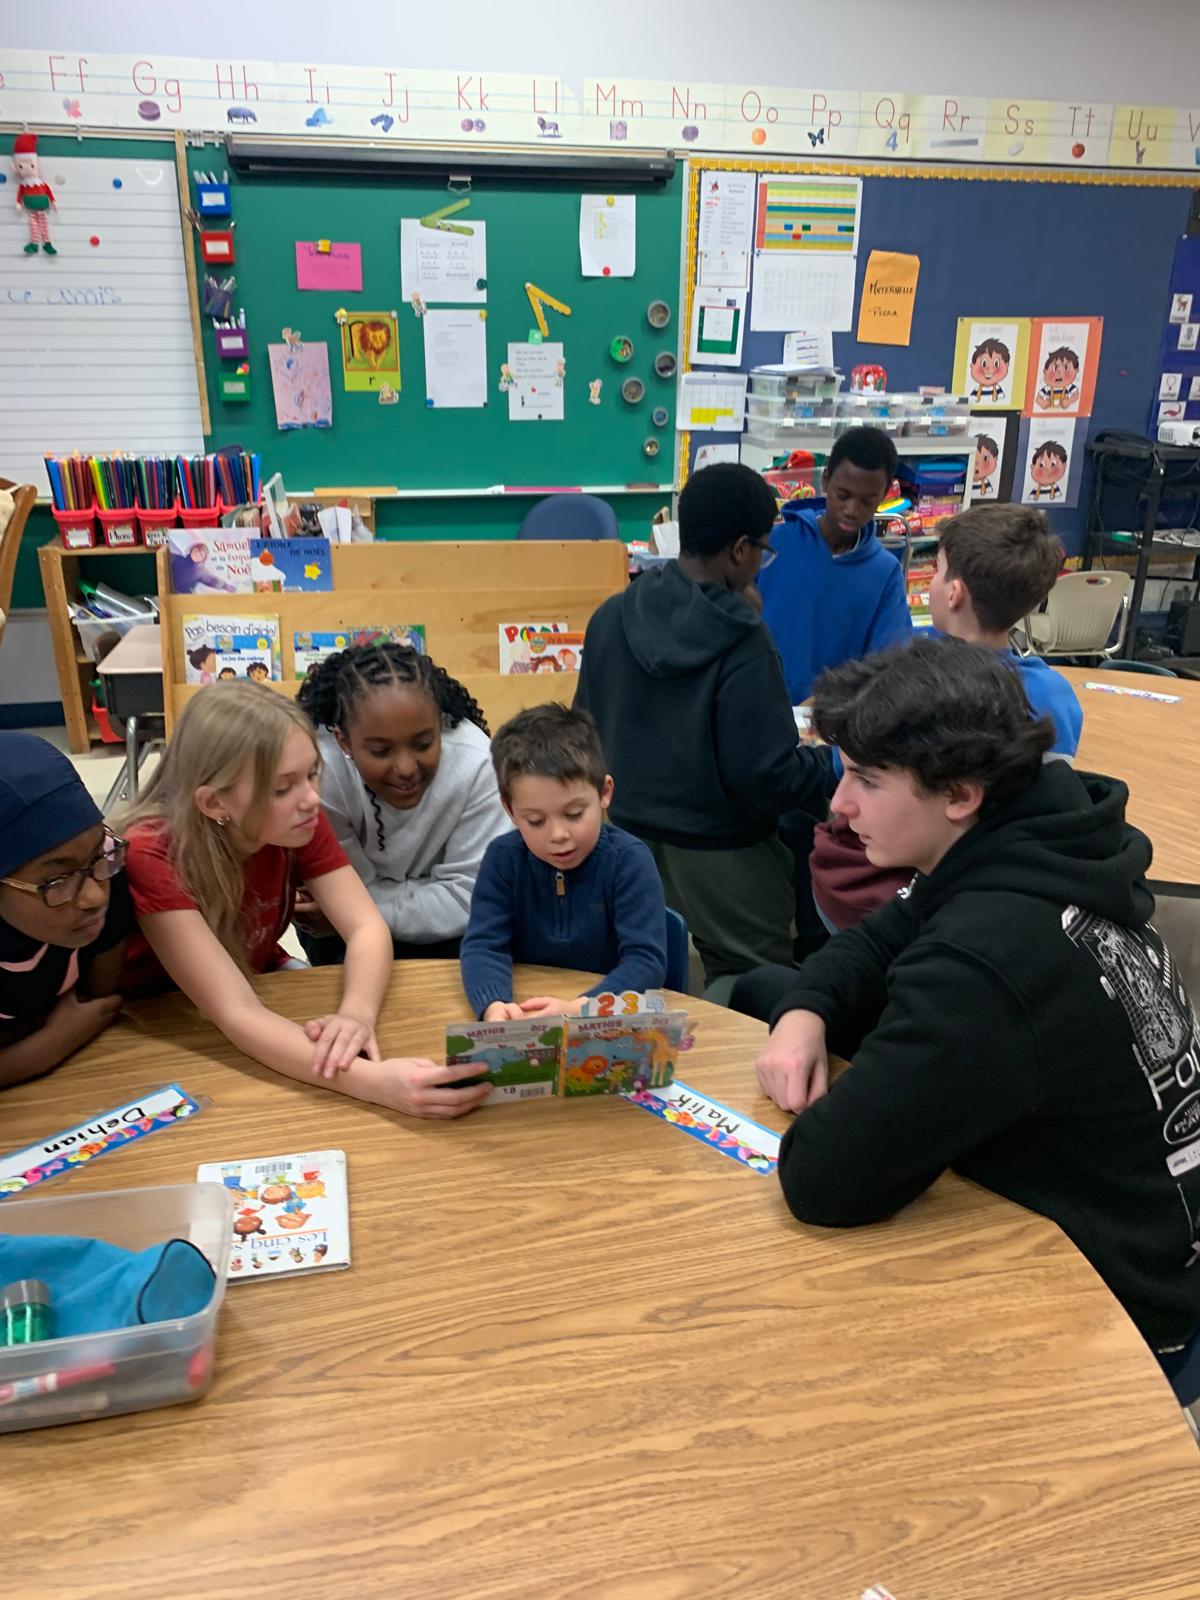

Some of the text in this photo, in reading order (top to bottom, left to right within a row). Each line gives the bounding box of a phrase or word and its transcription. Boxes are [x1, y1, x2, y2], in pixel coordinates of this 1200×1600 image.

[48, 55, 89, 93] Ff
[132, 60, 182, 113] Gg
[216, 64, 260, 101] Hh
[304, 67, 331, 104] Ii
[382, 72, 411, 123] Jj
[456, 76, 491, 111] Kk
[532, 80, 559, 113] Ll
[595, 83, 644, 118] Mm
[671, 86, 708, 121] Nn
[740, 91, 779, 124] Oo
[811, 94, 842, 141] Pp
[874, 98, 912, 143] Qq
[943, 100, 972, 132] Rr
[1004, 104, 1035, 137] Ss
[1067, 106, 1096, 139] Tt
[1127, 110, 1160, 142] Uu
[184, 624, 204, 640] Pas
[206, 618, 242, 635] besoin
[597, 994, 616, 1017] 2
[621, 992, 640, 1015] 3
[577, 1019, 623, 1032] MATHIS
[466, 1026, 505, 1040] MATHIS
[250, 1238, 291, 1250] cinq
[298, 1231, 327, 1244] Les
